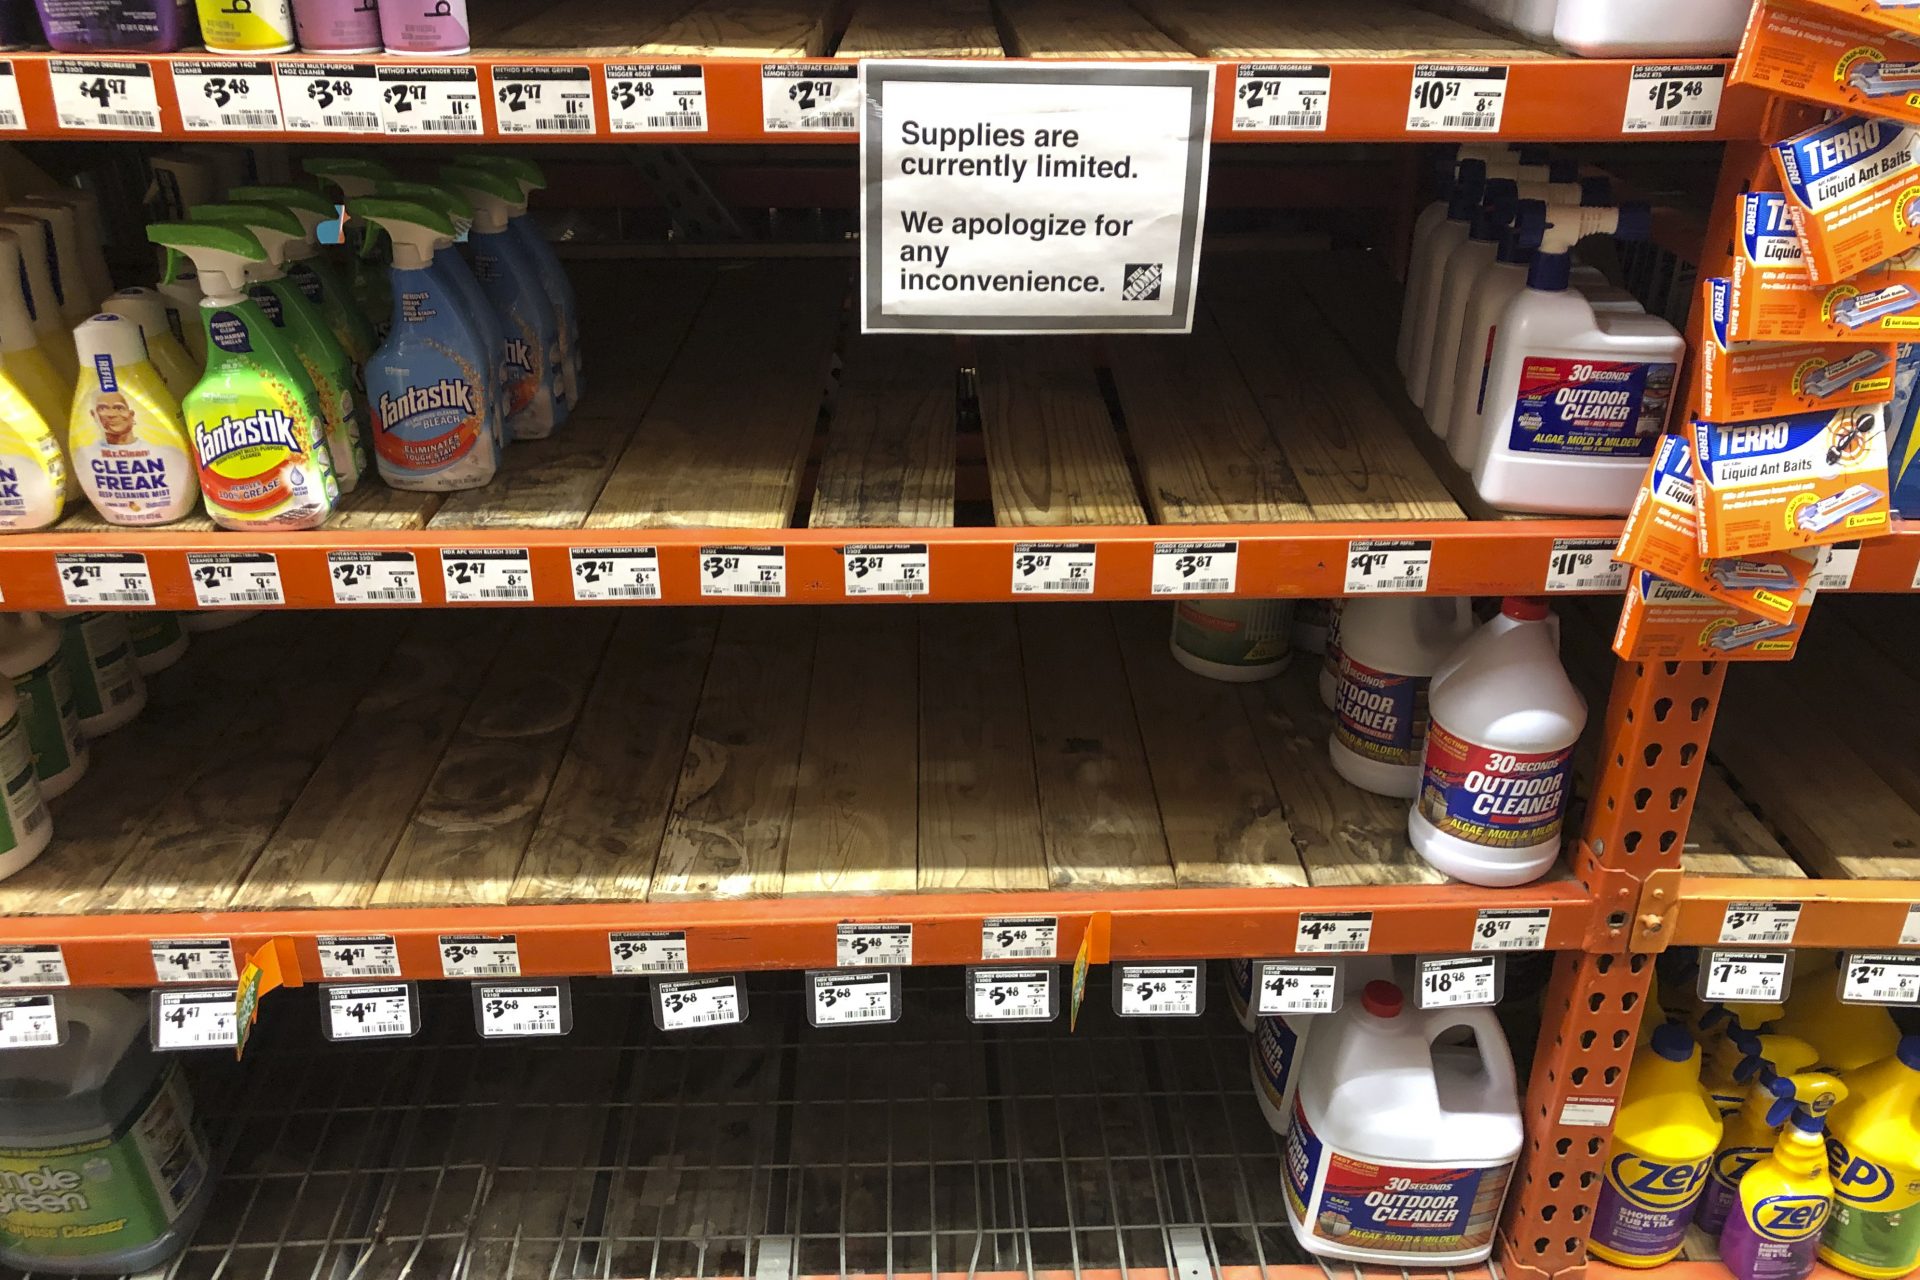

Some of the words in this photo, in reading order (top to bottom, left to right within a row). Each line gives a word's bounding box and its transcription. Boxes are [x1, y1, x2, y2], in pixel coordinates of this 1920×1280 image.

[901, 120, 1025, 152] Supplies
[1034, 129, 1079, 148] are
[1803, 120, 1881, 176] TERRO
[901, 153, 1027, 183] currently
[1036, 155, 1138, 178] limited.
[1819, 173, 1855, 201] Liquid
[1858, 165, 1880, 183] Ant
[1881, 150, 1911, 173] Baits
[901, 211, 944, 233] We
[952, 213, 1086, 241] apologize
[1095, 214, 1133, 237] for
[1746, 196, 1758, 235] TERRO
[900, 244, 950, 268] any
[901, 268, 1106, 292] inconvenience.
[1122, 264, 1162, 301] HOME
[1714, 285, 1725, 322] TERRO
[98, 361, 114, 390] REFILL
[1568, 364, 1593, 382] 30
[1590, 370, 1631, 381] SECONDS
[379, 379, 476, 431] fantastik
[1555, 388, 1630, 405] OUTDOOR
[423, 415, 460, 429] BLEACH
[1561, 404, 1631, 421] CLEANER
[196, 410, 302, 467] fantastik
[404, 433, 460, 454] ELIMINATES
[1533, 433, 1565, 444] ALGAE,
[1567, 436, 1595, 445] MOLD
[1596, 437, 1603, 446] &
[1604, 438, 1642, 447] MILDEW
[1717, 422, 1788, 456] TERRO
[91, 458, 165, 475] CLEAN
[406, 452, 431, 462] TOUGH
[1722, 465, 1757, 481] Liquid
[1760, 463, 1779, 475] Ant
[1783, 460, 1812, 473] Baits
[95, 474, 168, 490] FREAK
[243, 480, 279, 499] GREASE
[152, 489, 170, 498] MIST
[1654, 586, 1690, 600] Liquid
[1363, 741, 1403, 757] MILDEW
[1443, 734, 1469, 753] ACTING
[1485, 752, 1517, 773] 30
[1513, 759, 1560, 772] SECONDS
[1464, 770, 1564, 797] OUTDOOR
[1472, 790, 1562, 816] CLEANER
[1488, 828, 1519, 840] MOLD
[1520, 829, 1529, 839] &
[1828, 1137, 1879, 1186] ep
[1384, 1177, 1411, 1192] 30
[1408, 1183, 1453, 1191] SECONDS
[1364, 1191, 1459, 1209] OUTDOOR
[1372, 1206, 1459, 1222] CLEANER
[1618, 1215, 1640, 1226] TUB
[1642, 1216, 1651, 1227] &
[1652, 1218, 1675, 1228] TILE
